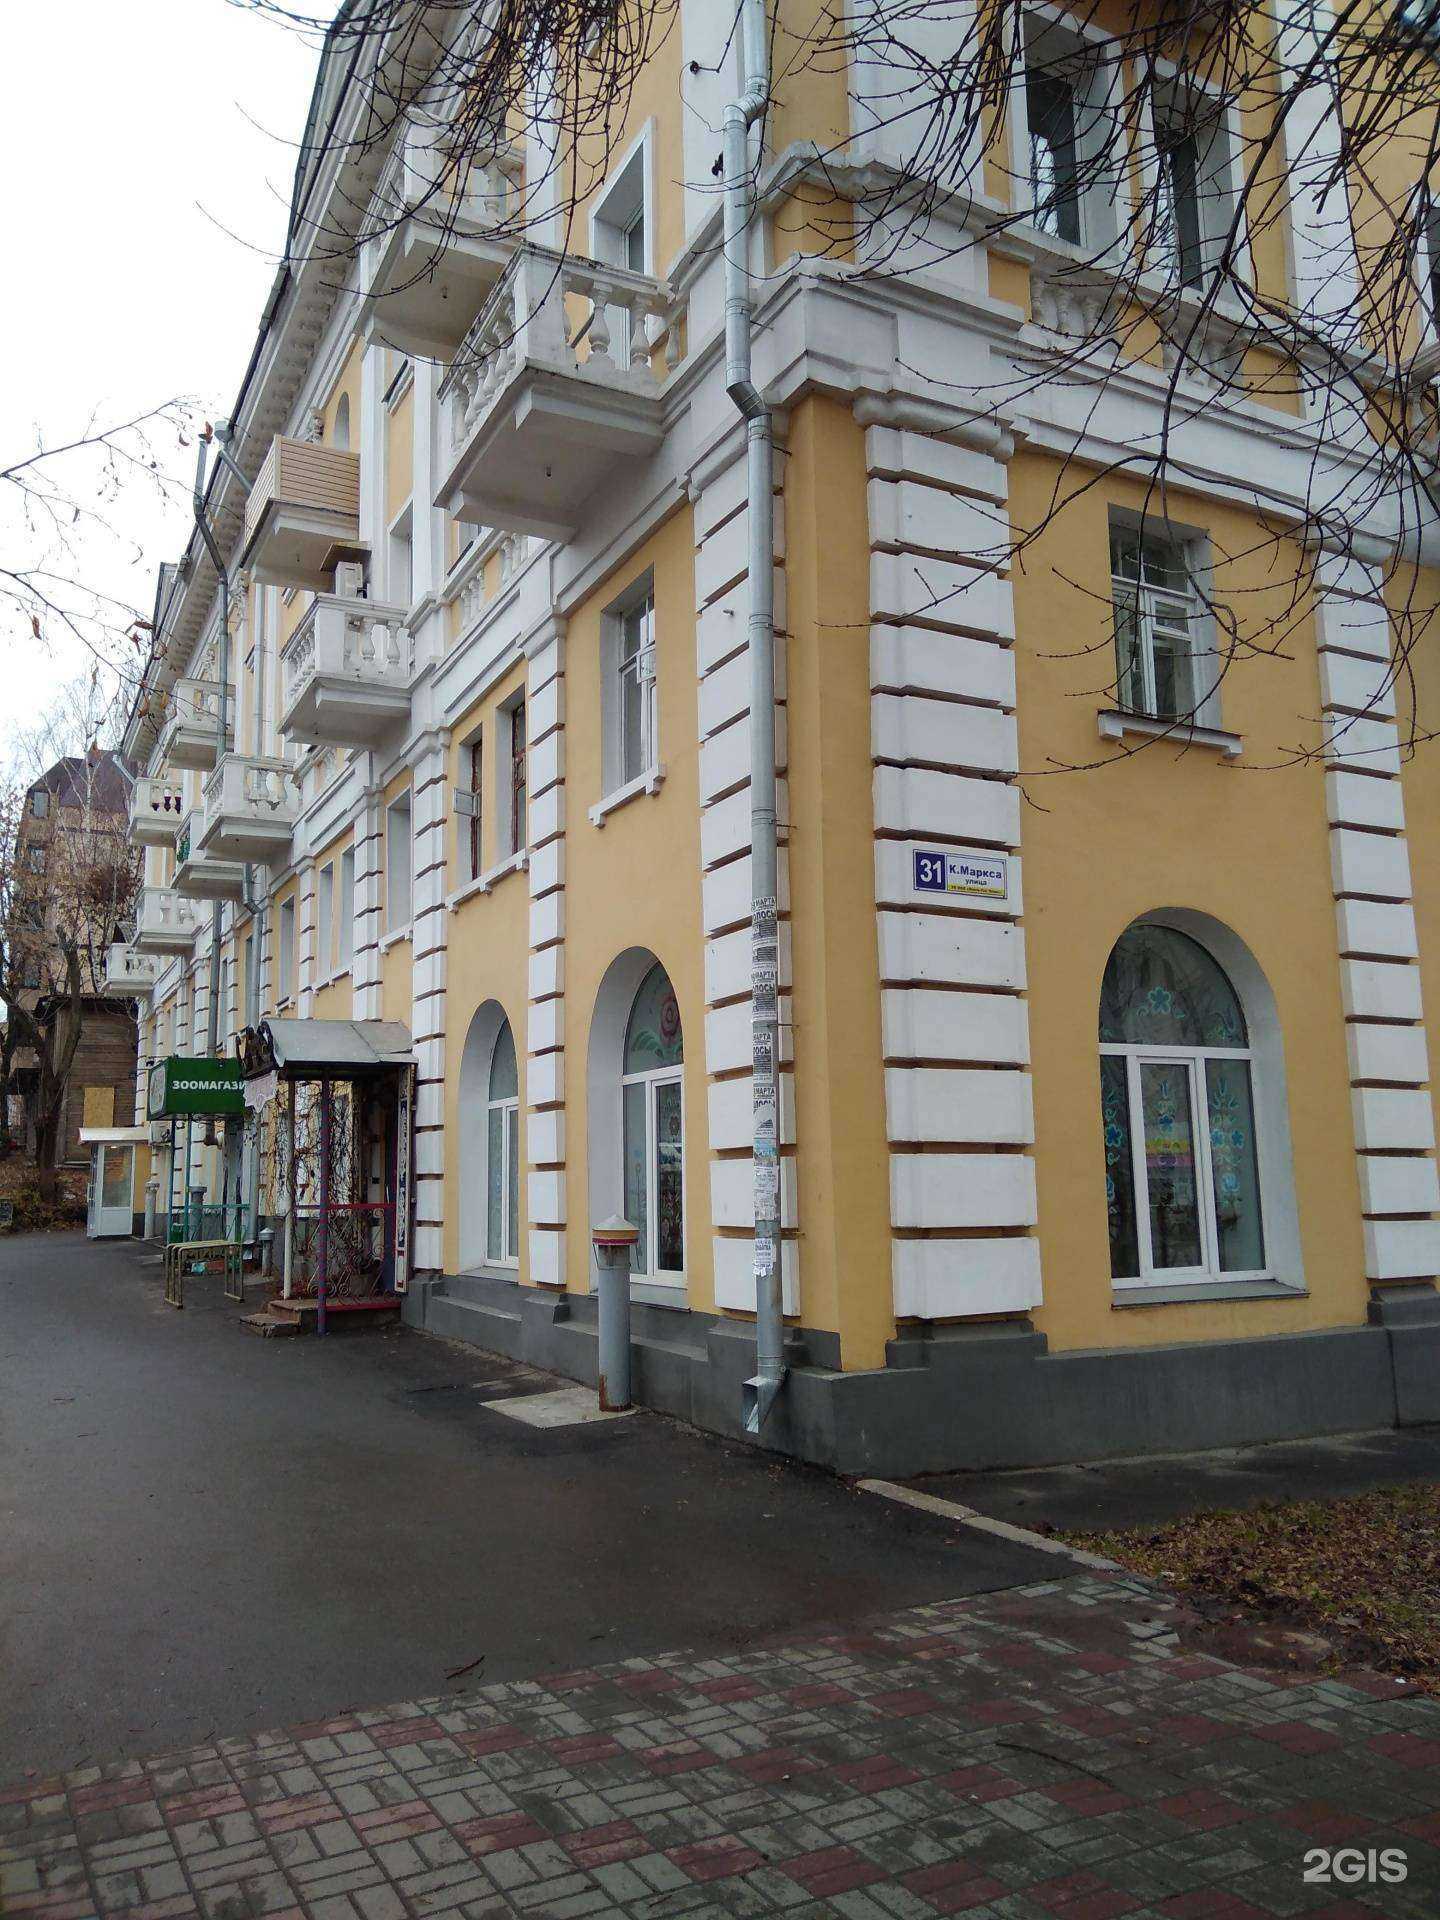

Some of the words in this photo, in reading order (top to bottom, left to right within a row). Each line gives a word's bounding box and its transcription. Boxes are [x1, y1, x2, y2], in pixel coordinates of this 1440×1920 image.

[920, 858, 942, 884] 31
[949, 864, 1002, 879] К.Маркса
[172, 1080, 247, 1090] ЗООМАГАЗИ
